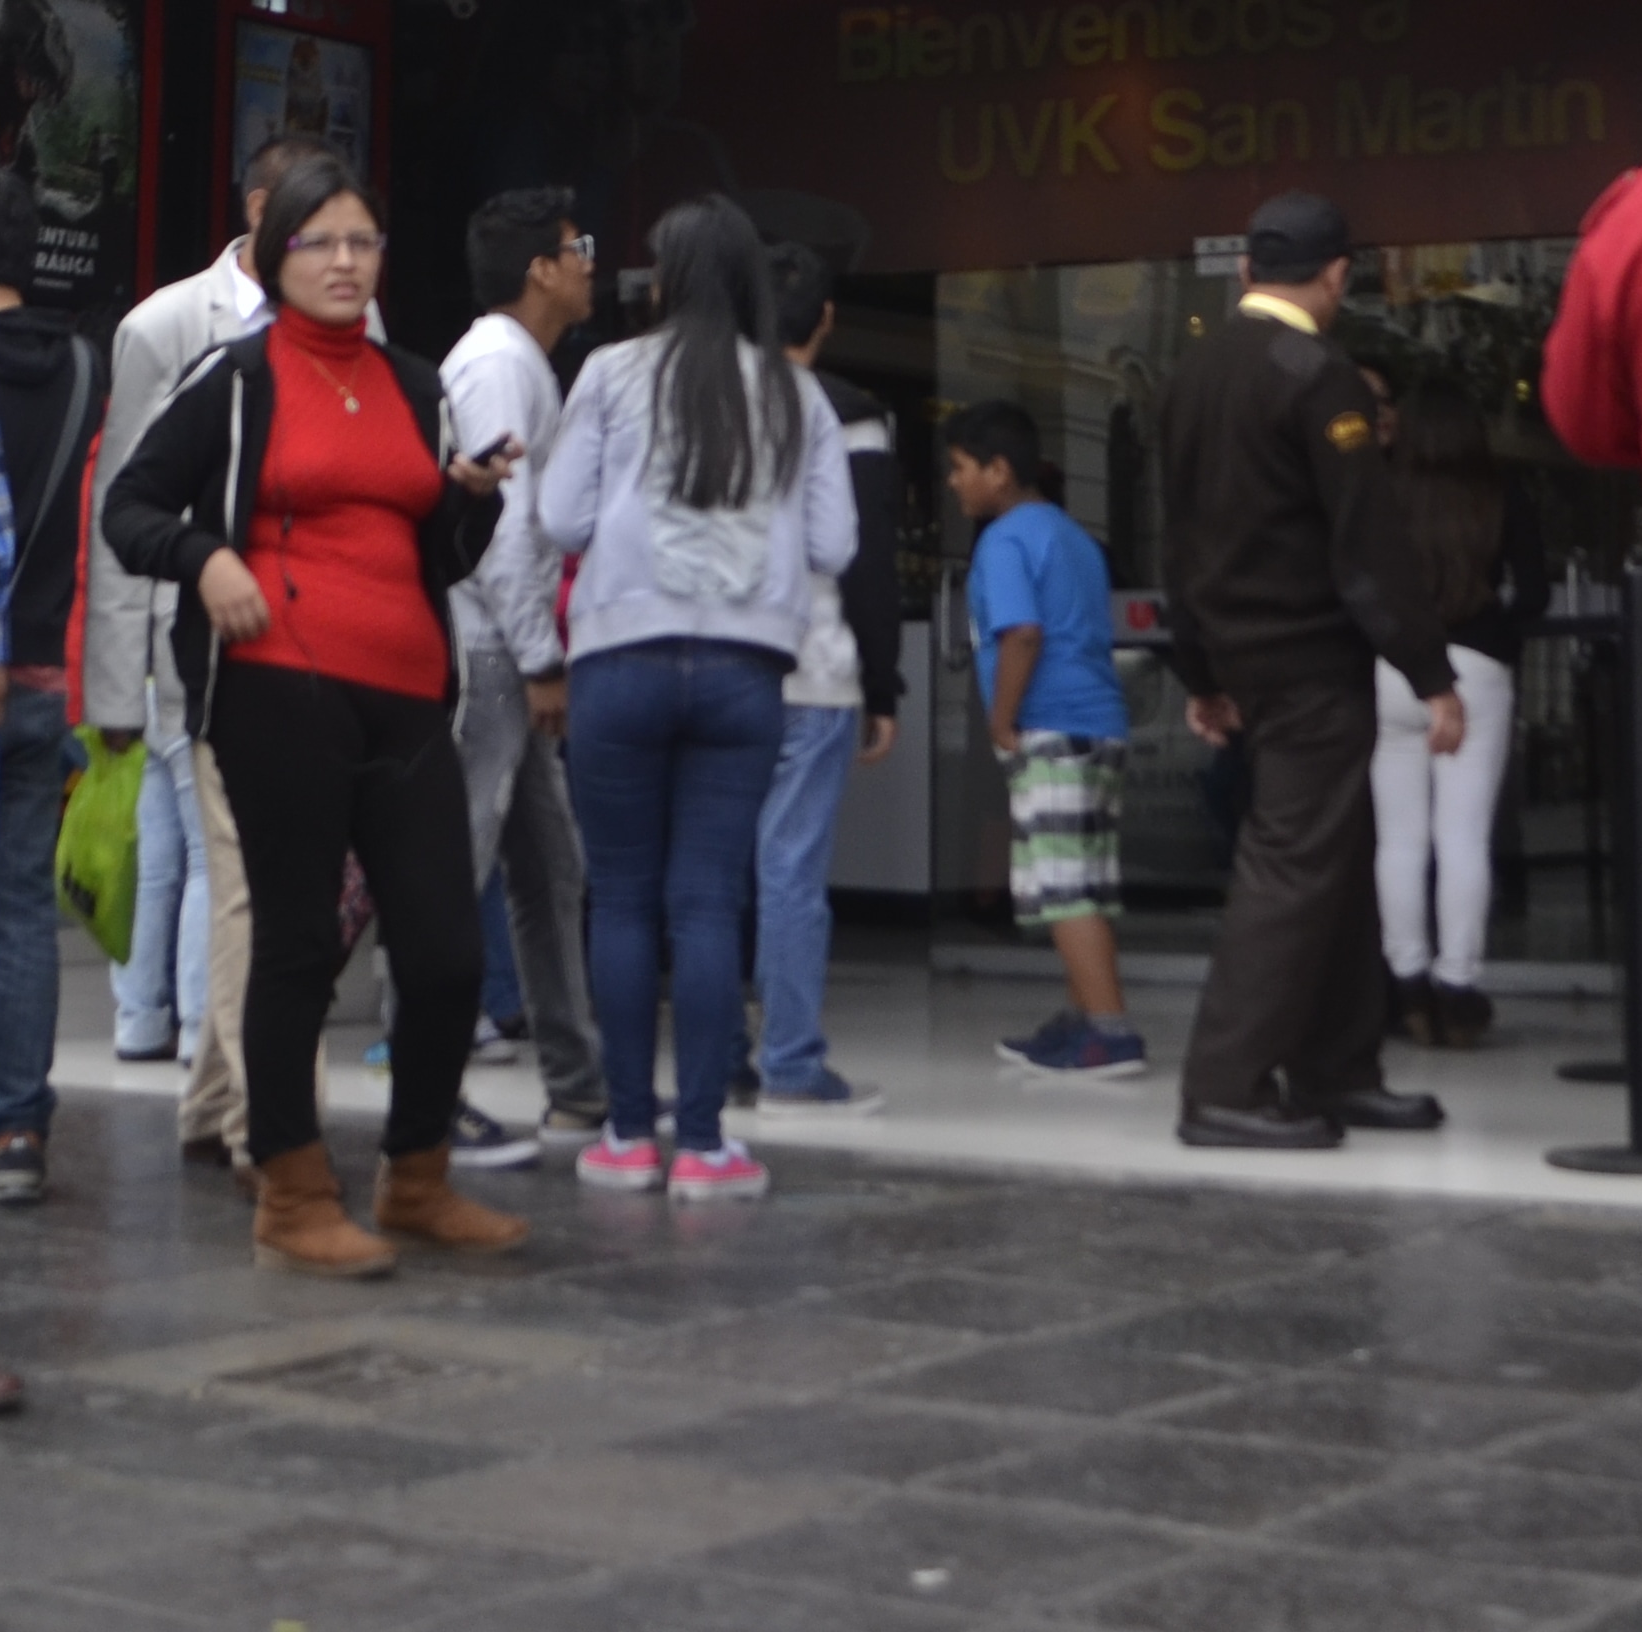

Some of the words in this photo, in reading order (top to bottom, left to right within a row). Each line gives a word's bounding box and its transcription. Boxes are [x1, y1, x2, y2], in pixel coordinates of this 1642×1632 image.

[937, 94, 1122, 184] UVK
[1149, 87, 1312, 173] San
[1334, 61, 1607, 159] Martín
